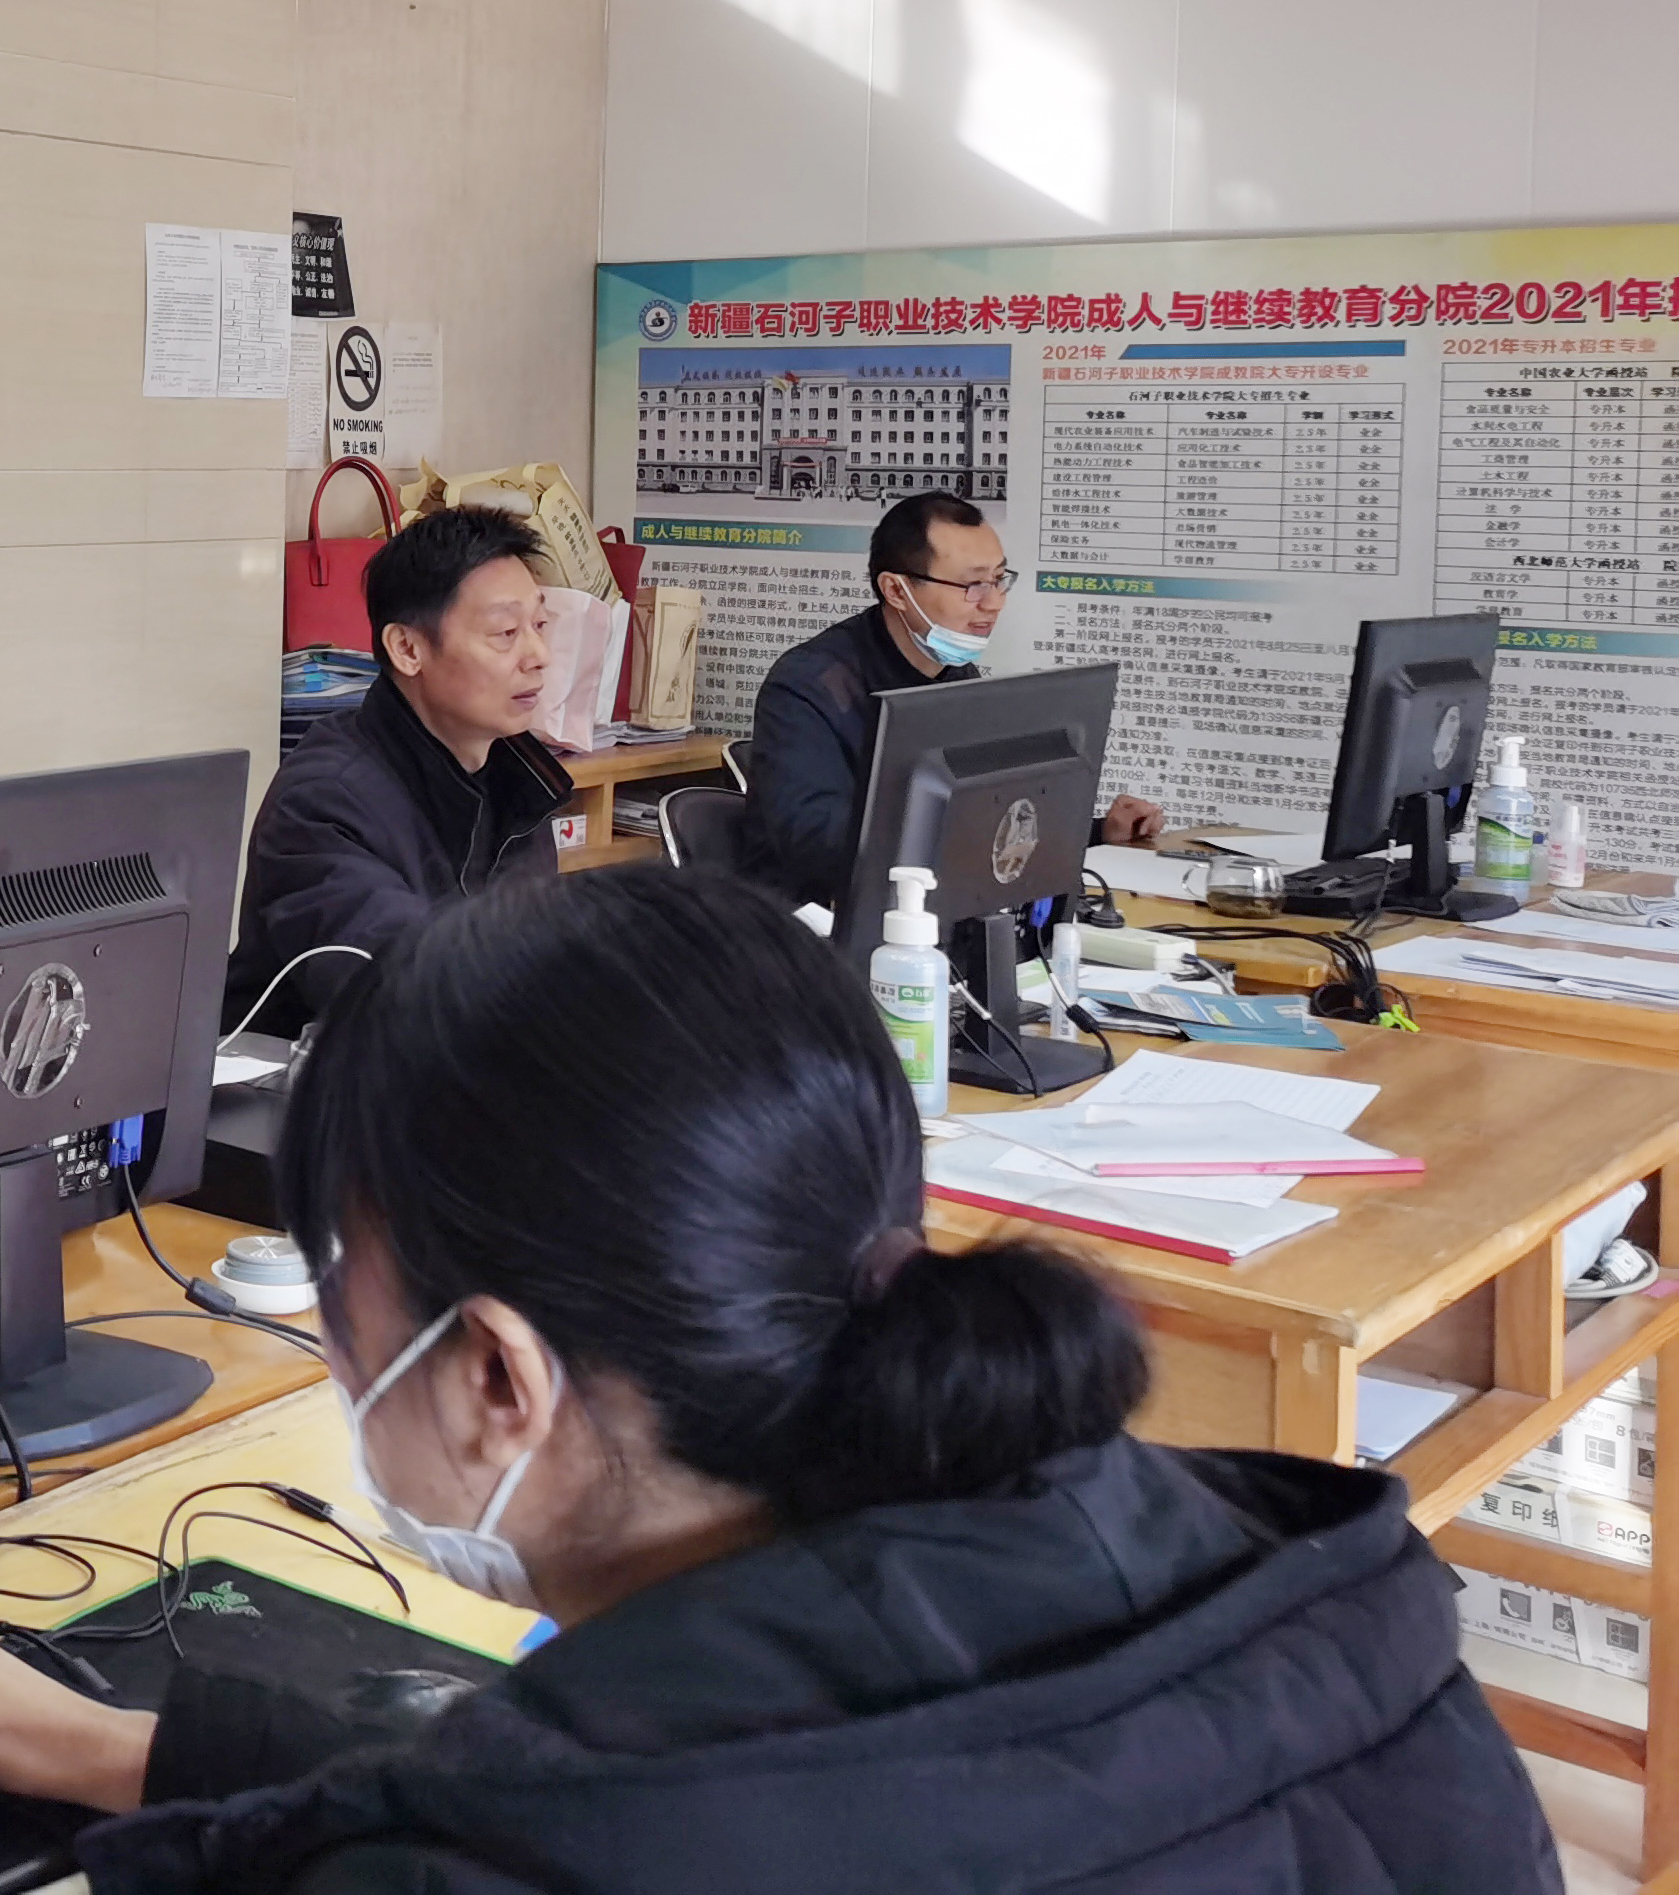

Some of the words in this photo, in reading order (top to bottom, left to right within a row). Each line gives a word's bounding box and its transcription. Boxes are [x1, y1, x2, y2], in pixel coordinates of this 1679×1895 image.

[687, 277, 1679, 337] 新疆石河子职业技术学院成人与继续教育分院2021年
[1042, 344, 1107, 361] 2021年
[1443, 337, 1657, 356] 2021年专升本招生专业
[1651, 386, 1679, 397] 学习
[333, 418, 345, 431] NO
[347, 419, 383, 433] SMOKING
[342, 440, 377, 455] 禁止吸烟
[641, 526, 803, 546] 成人与继续教育分院简介
[1614, 1526, 1652, 1546] APP
